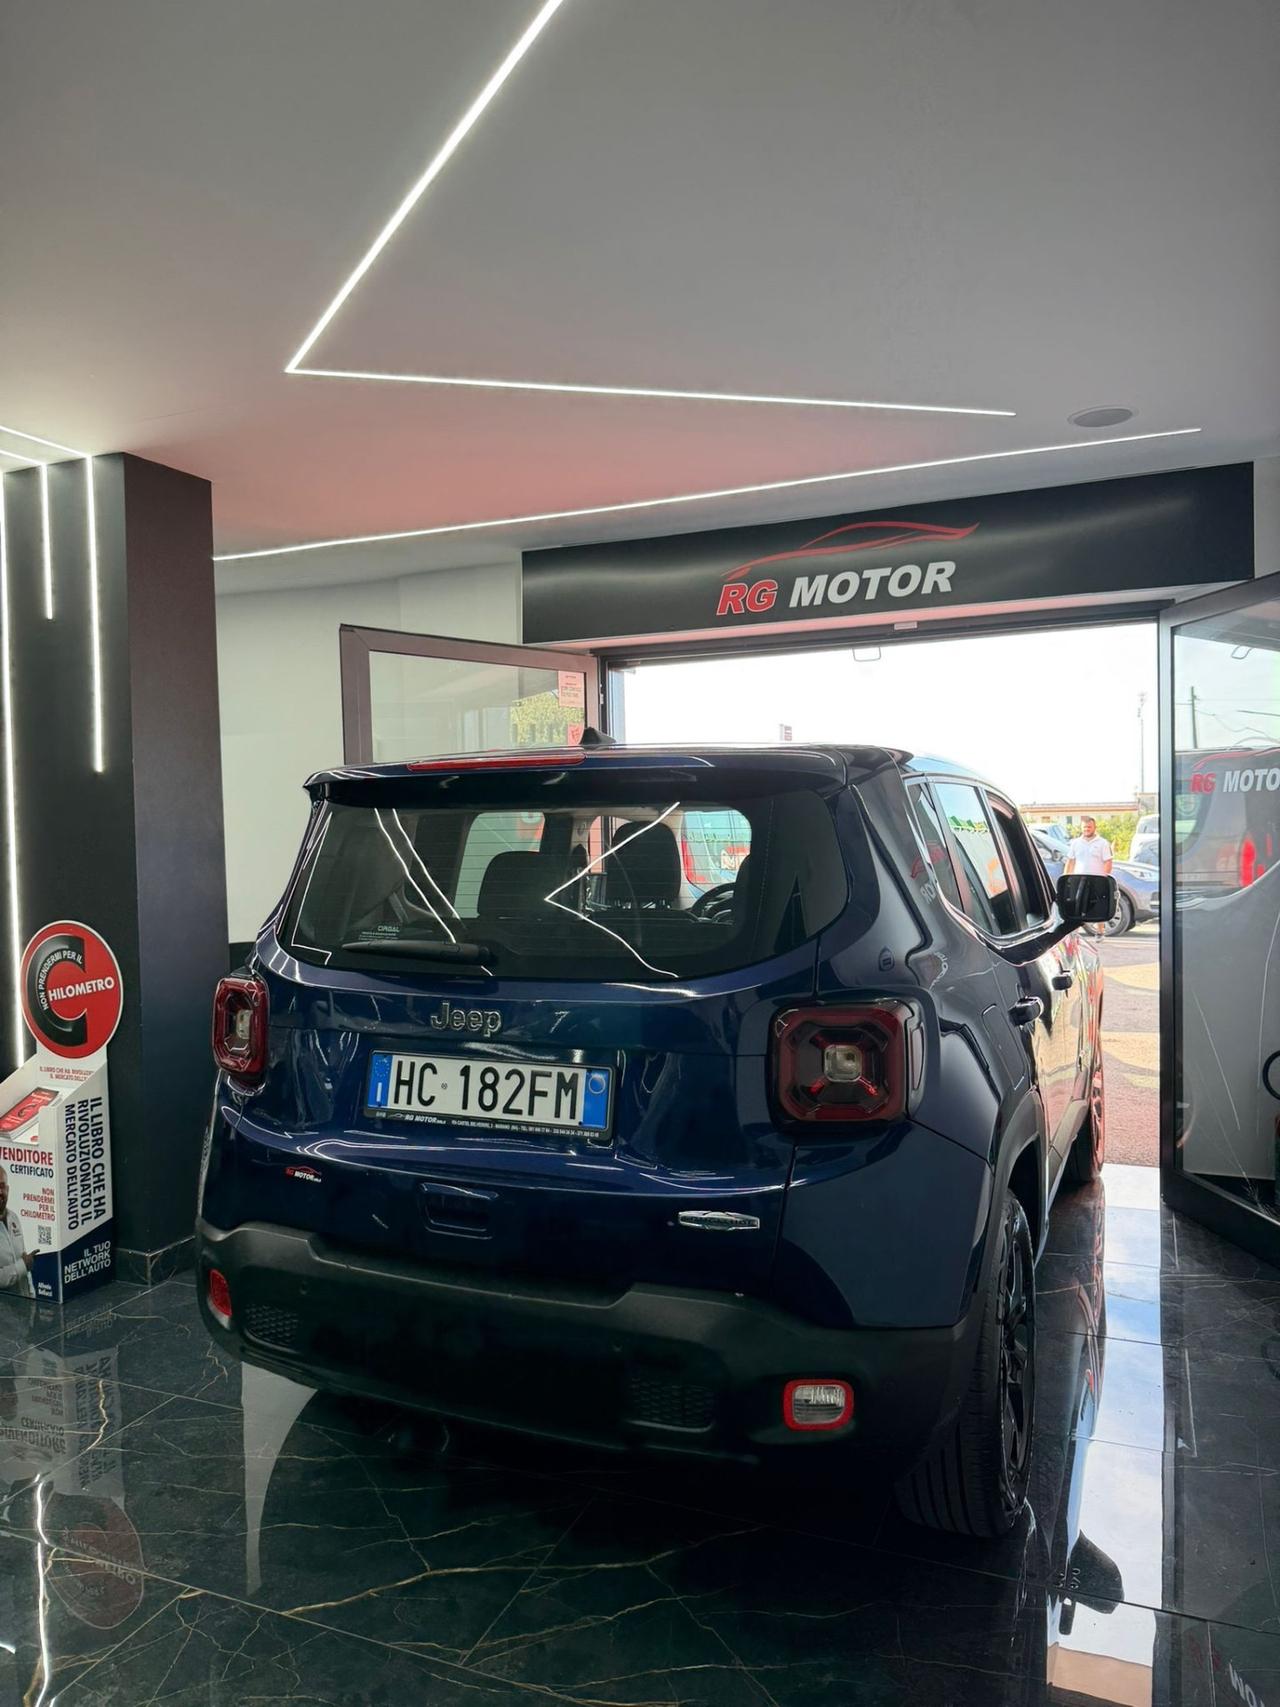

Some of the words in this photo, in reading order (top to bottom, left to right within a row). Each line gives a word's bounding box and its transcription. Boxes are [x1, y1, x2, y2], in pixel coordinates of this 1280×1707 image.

[716, 579, 779, 616] RG
[789, 560, 956, 608] MOTOR
[1189, 772, 1217, 795] RG
[38, 951, 62, 990] PRENDERMI
[62, 950, 76, 961] PER
[430, 1002, 502, 1037] Jeep
[393, 1060, 438, 1107] HC
[459, 1065, 579, 1120] 182FM
[90, 1096, 102, 1111] IL
[415, 1115, 437, 1123] MOTOR
[65, 1103, 77, 1163] MERCATO
[91, 1113, 104, 1159] LIBRO
[78, 1099, 92, 1209] RIVOLUZIONATO
[10, 1163, 54, 1178] CERTIFICATO
[92, 1163, 105, 1194] CHE
[294, 1170, 314, 1181] MOTOR
[67, 1165, 79, 1230] DELL'AUTO
[93, 1195, 106, 1220] HA
[81, 1211, 92, 1225] IL
[64, 1249, 111, 1275] NETWORK
[84, 1248, 92, 1258] IL
[93, 1240, 111, 1253] TUO
[64, 1259, 111, 1284] DELL'AUTO
